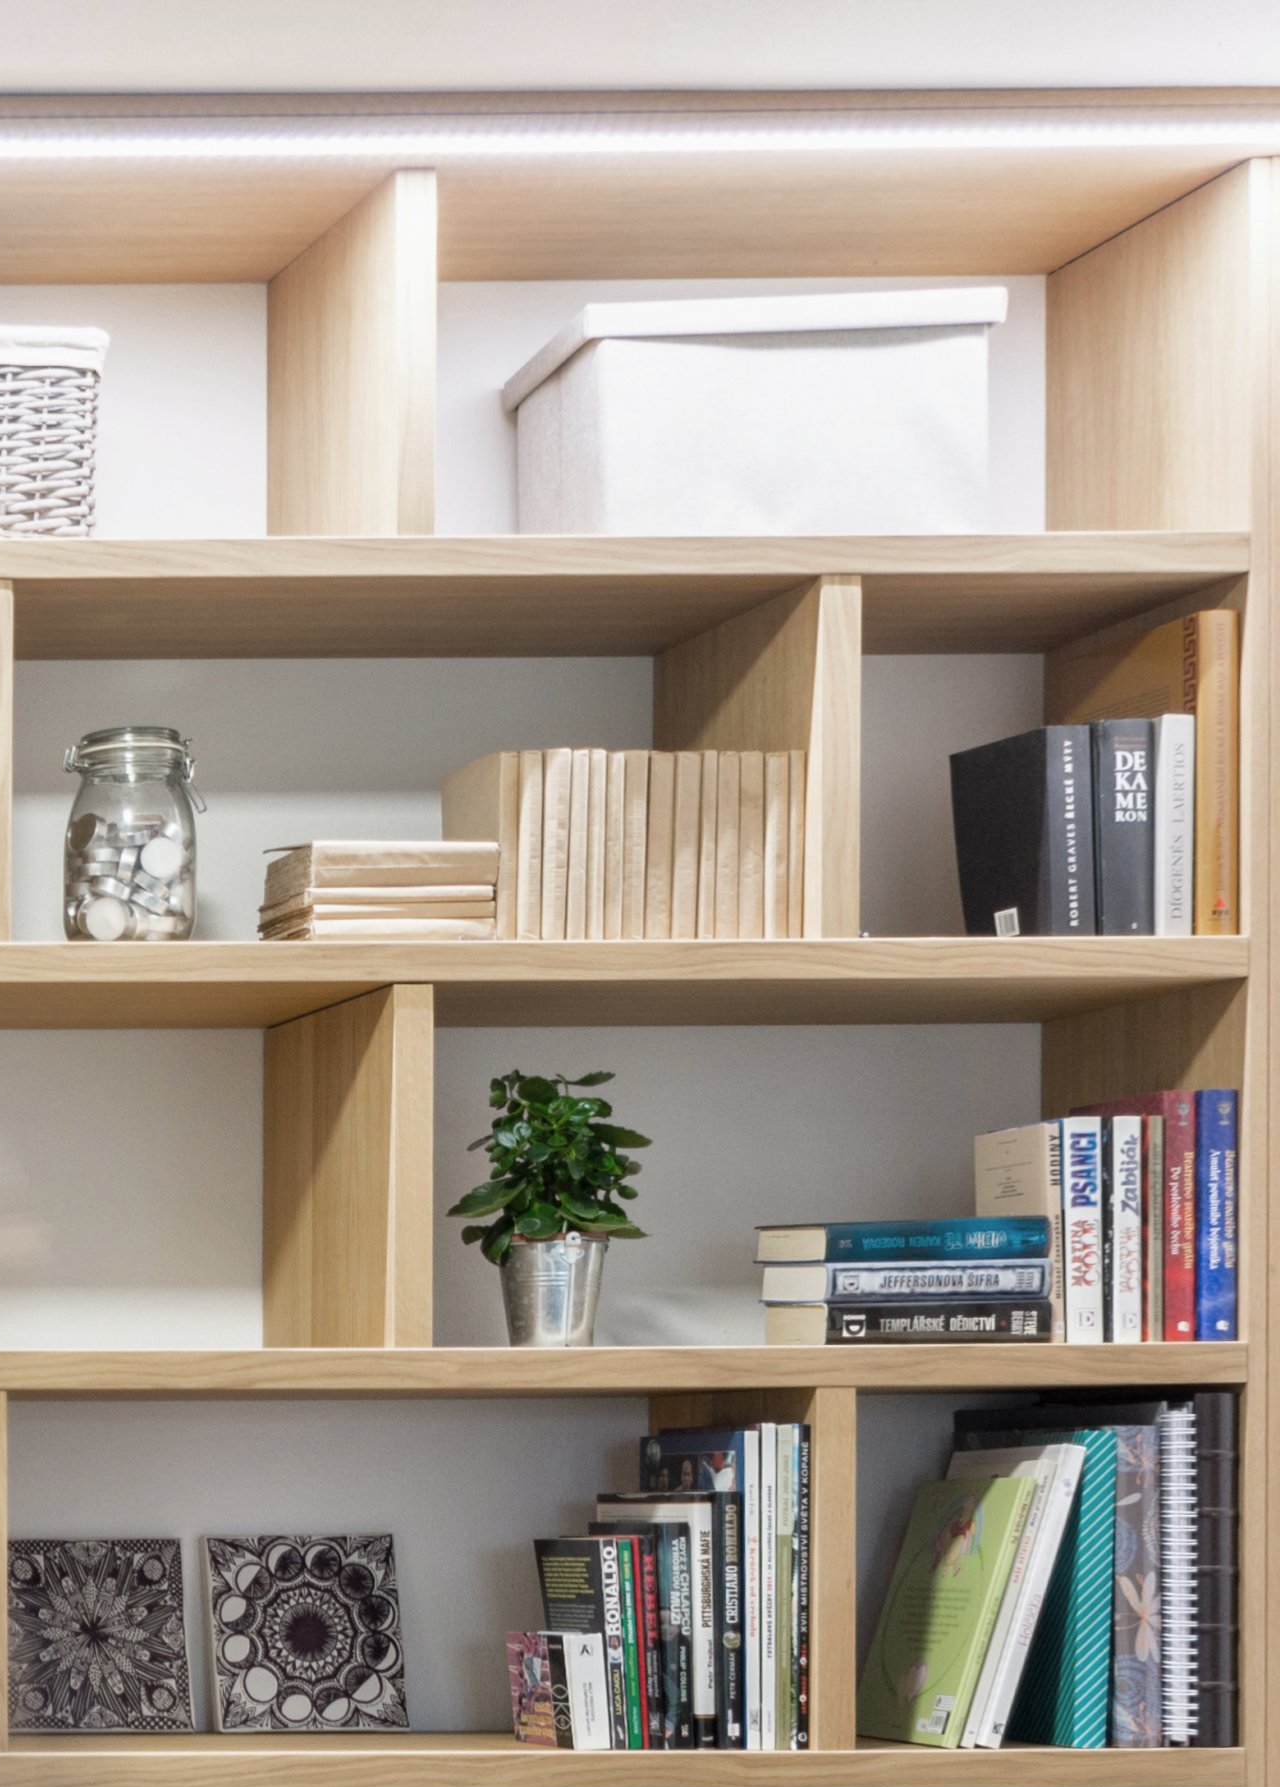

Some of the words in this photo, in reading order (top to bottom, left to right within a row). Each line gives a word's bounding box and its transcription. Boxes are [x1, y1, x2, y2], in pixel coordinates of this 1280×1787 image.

[1114, 751, 1146, 771] DE
[1114, 772, 1147, 790] KA
[1114, 793, 1147, 810] ME
[1114, 811, 1147, 822] RON
[1066, 824, 1078, 873] GRAVES
[1068, 878, 1080, 927] ROBERT
[1049, 1134, 1062, 1185] HODINY
[1070, 1131, 1096, 1207] PSANCI
[1119, 1133, 1139, 1216] Zabiják
[1071, 1219, 1083, 1286] MARTINA
[880, 1275, 962, 1288] JEFFERSONOVA
[967, 1273, 999, 1286] ŠIFRA
[880, 1314, 944, 1332] TEMPLÁŘSKÉ
[949, 1313, 996, 1331] DĚDICTVÍ
[800, 1498, 808, 1530] SVĚTA
[699, 1530, 710, 1554] MAFIE
[602, 1546, 620, 1635] RONALDO
[698, 1557, 712, 1627] PITTSBURGHSKÁ
[724, 1565, 738, 1623] CRISTIANO
[799, 1534, 809, 1605] MISTROVSTVÍ
[613, 1694, 622, 1714] LUCA
